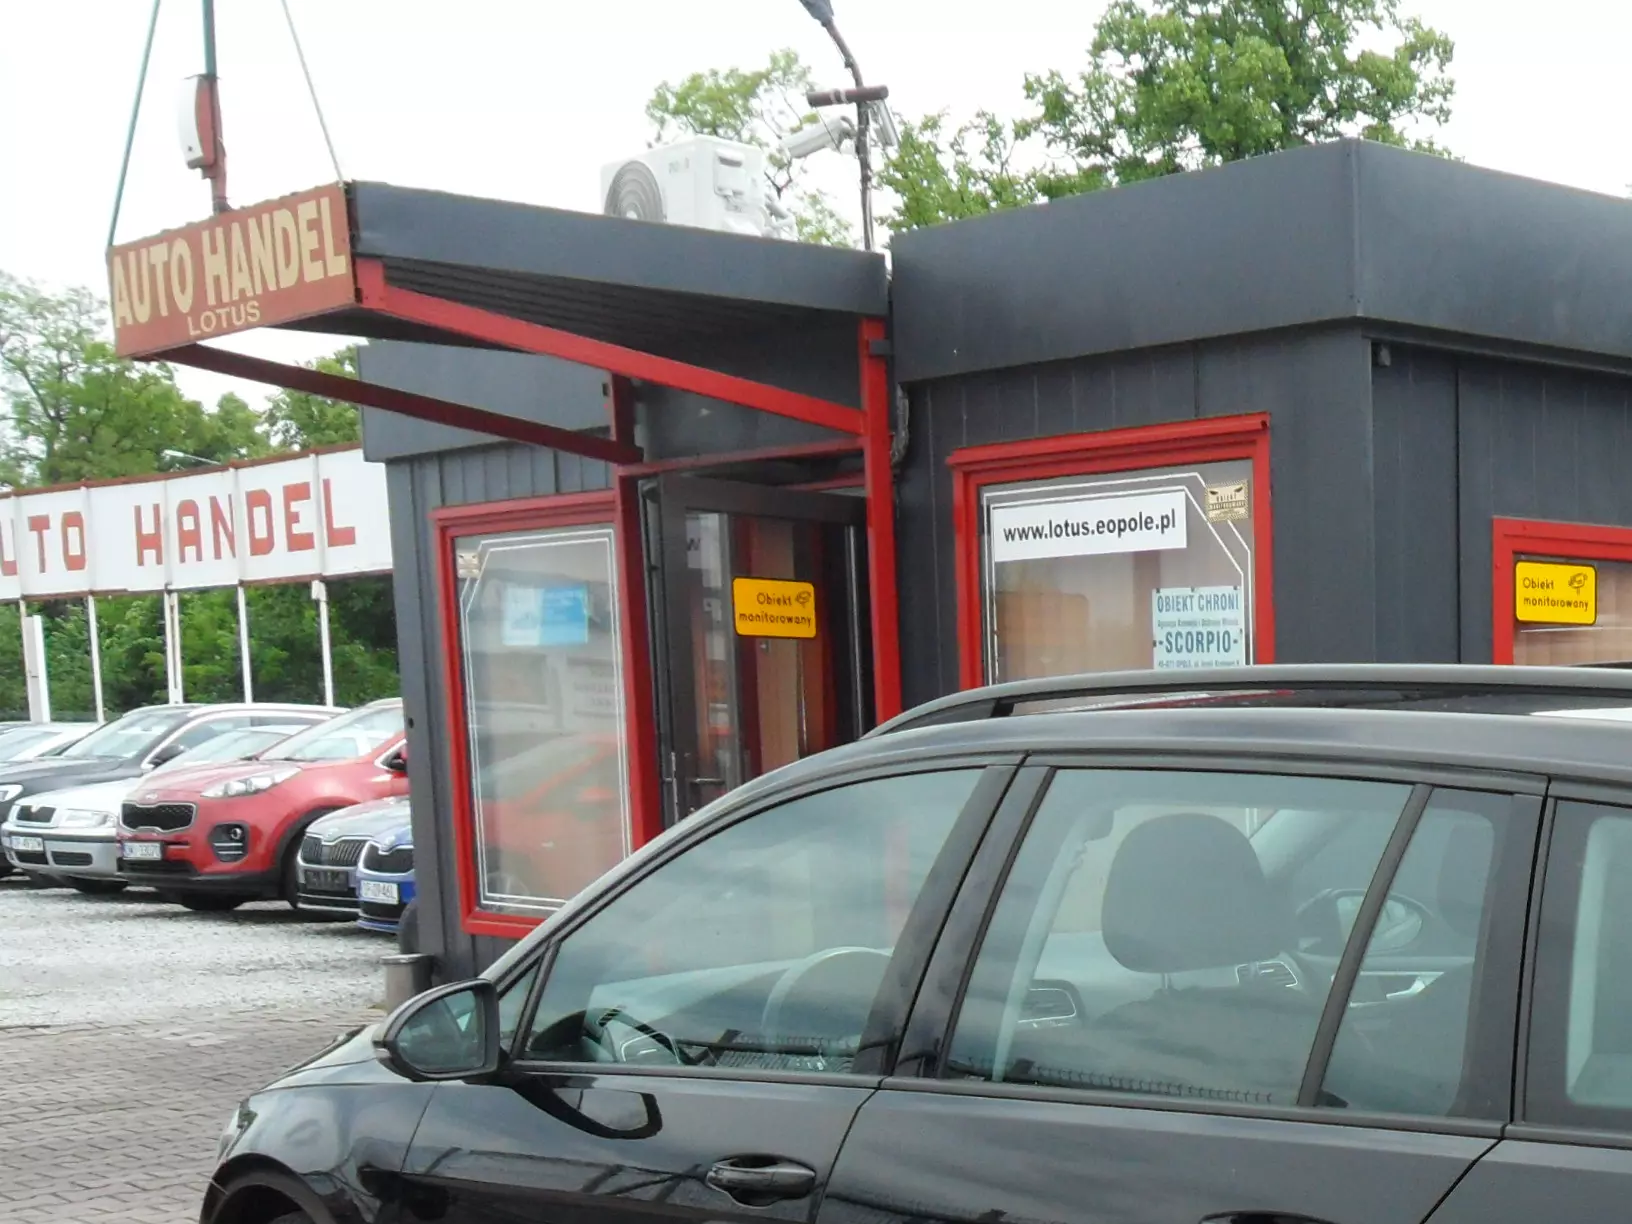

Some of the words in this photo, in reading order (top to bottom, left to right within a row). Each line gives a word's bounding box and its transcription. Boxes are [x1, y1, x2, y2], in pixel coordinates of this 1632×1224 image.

[112, 238, 194, 329] AUTO
[201, 196, 348, 306] HANDEL
[187, 300, 261, 336] LOTUS
[134, 478, 357, 567] HANDEL
[1003, 508, 1176, 542] www.lotus.eopole.pl
[1522, 576, 1555, 590] Obiekt
[756, 592, 793, 607] Obiekt
[1157, 594, 1195, 613] OBIEKT
[1523, 595, 1589, 613] monitorowany
[739, 610, 812, 629] monitorowany
